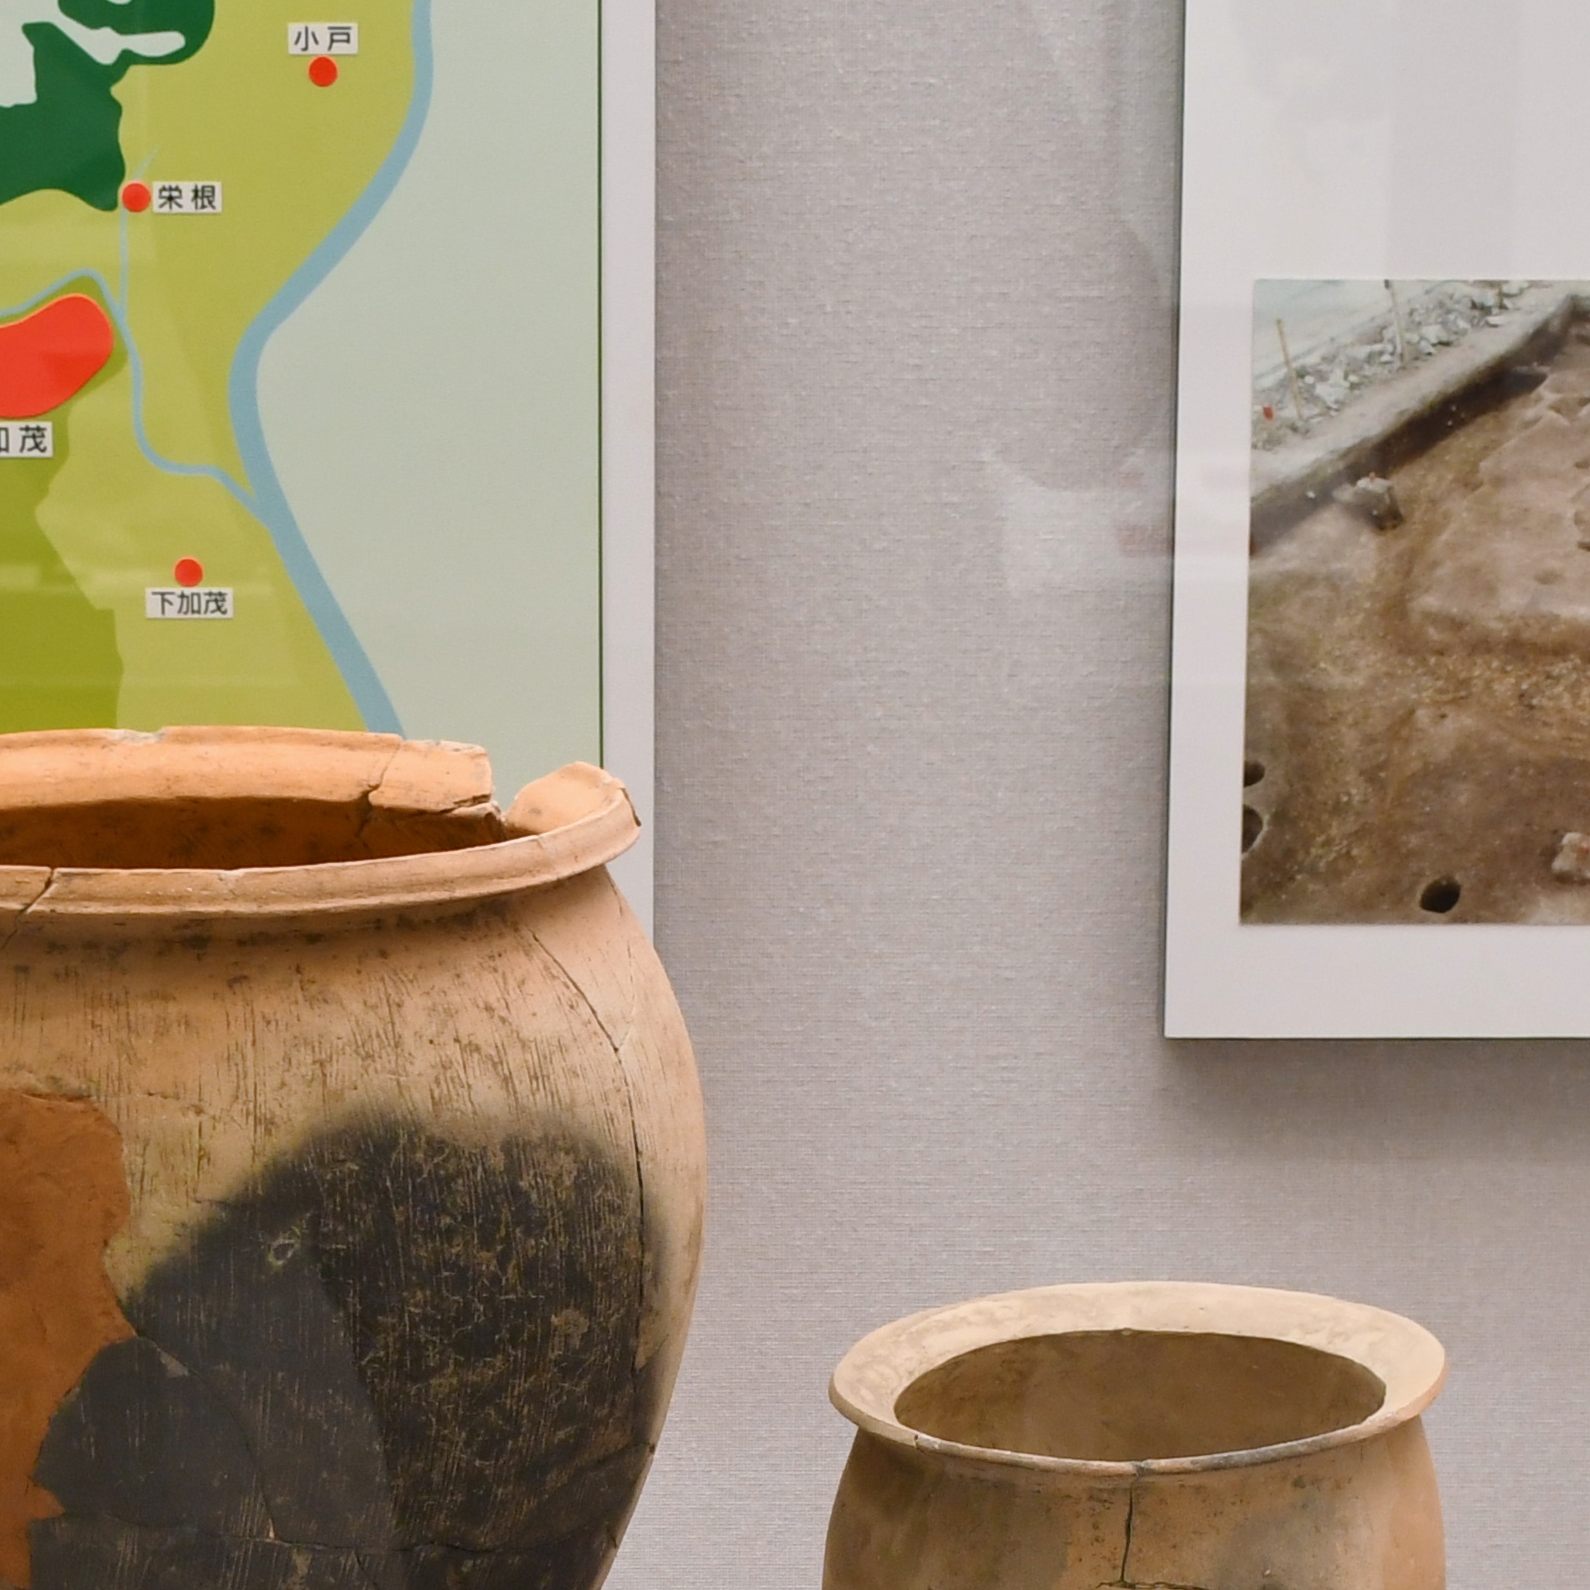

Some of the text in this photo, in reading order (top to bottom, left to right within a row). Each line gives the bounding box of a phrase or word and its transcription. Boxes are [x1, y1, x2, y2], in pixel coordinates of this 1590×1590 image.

[288, 25, 359, 57] 小戸
[158, 184, 216, 211] 栄根
[151, 590, 228, 616] 下加茂
